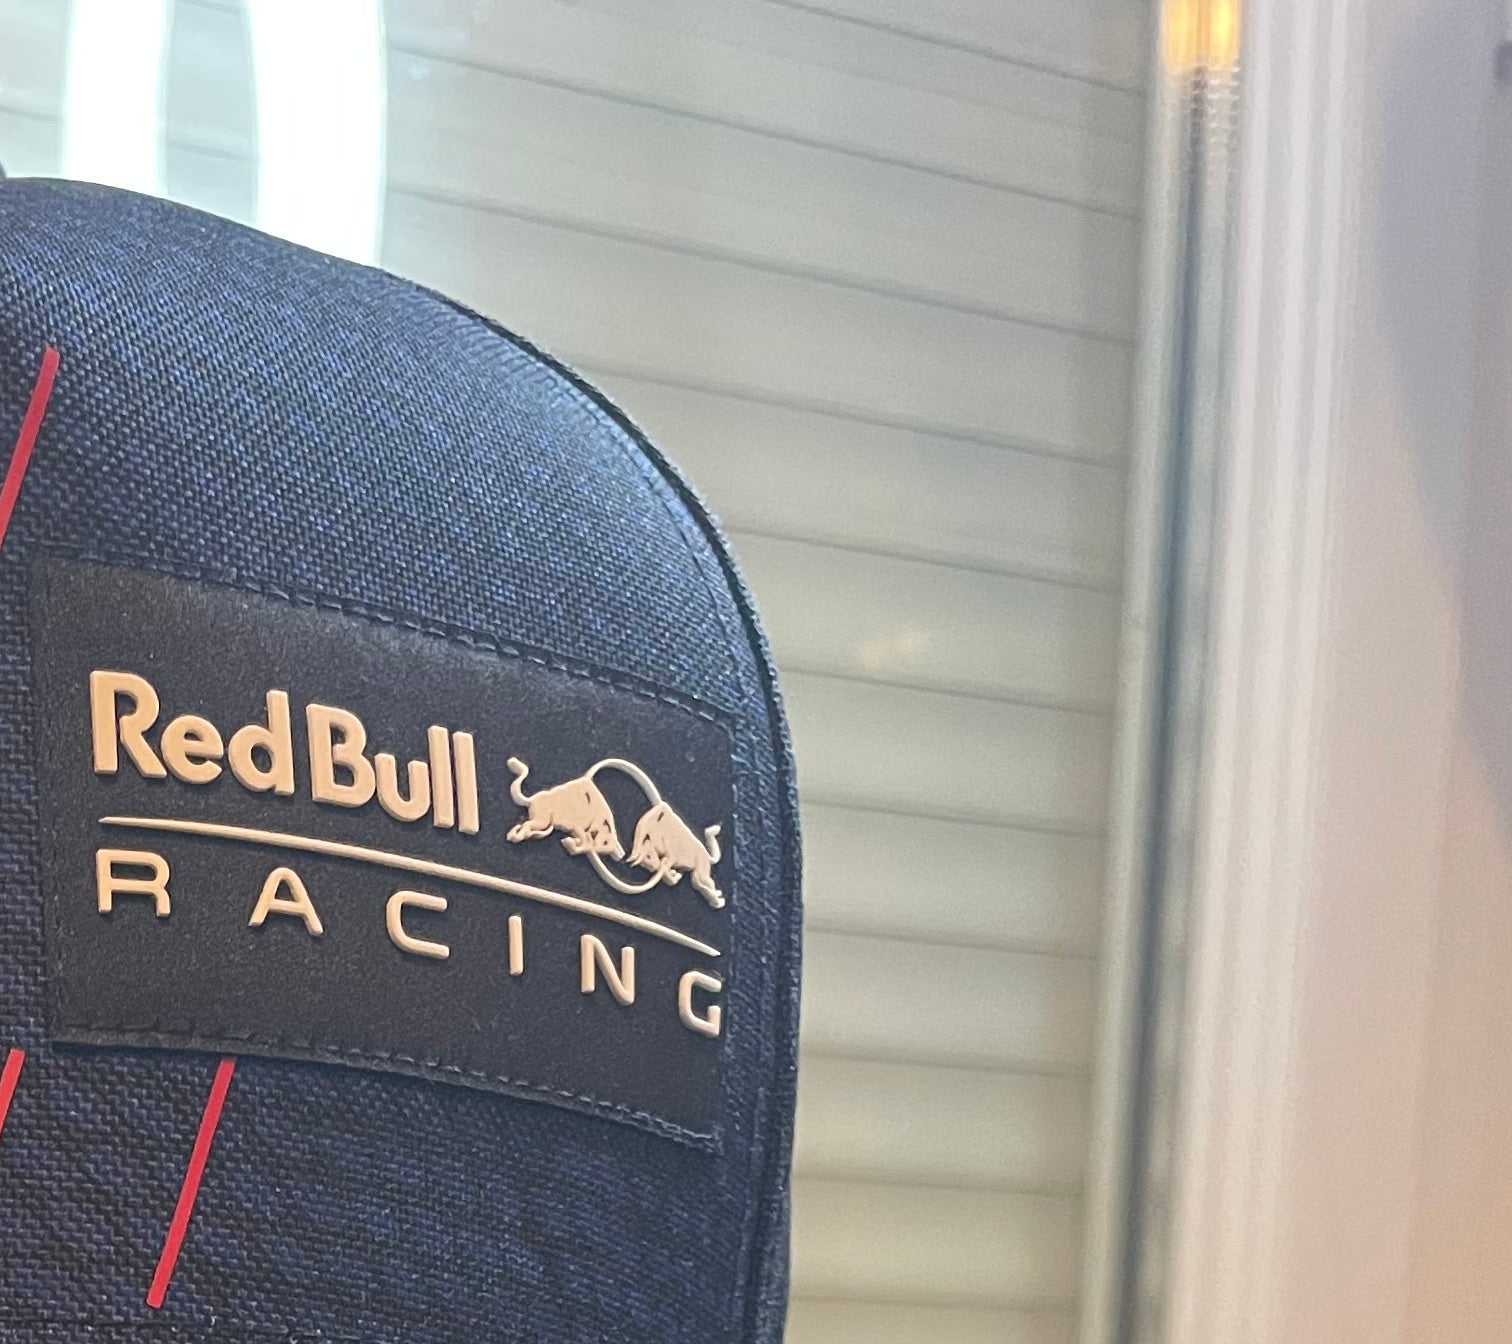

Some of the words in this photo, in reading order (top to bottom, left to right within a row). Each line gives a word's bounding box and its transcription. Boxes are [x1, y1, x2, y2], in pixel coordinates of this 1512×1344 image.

[89, 669, 295, 796] Red
[306, 702, 480, 834] Bull
[96, 848, 722, 1037] RACING
